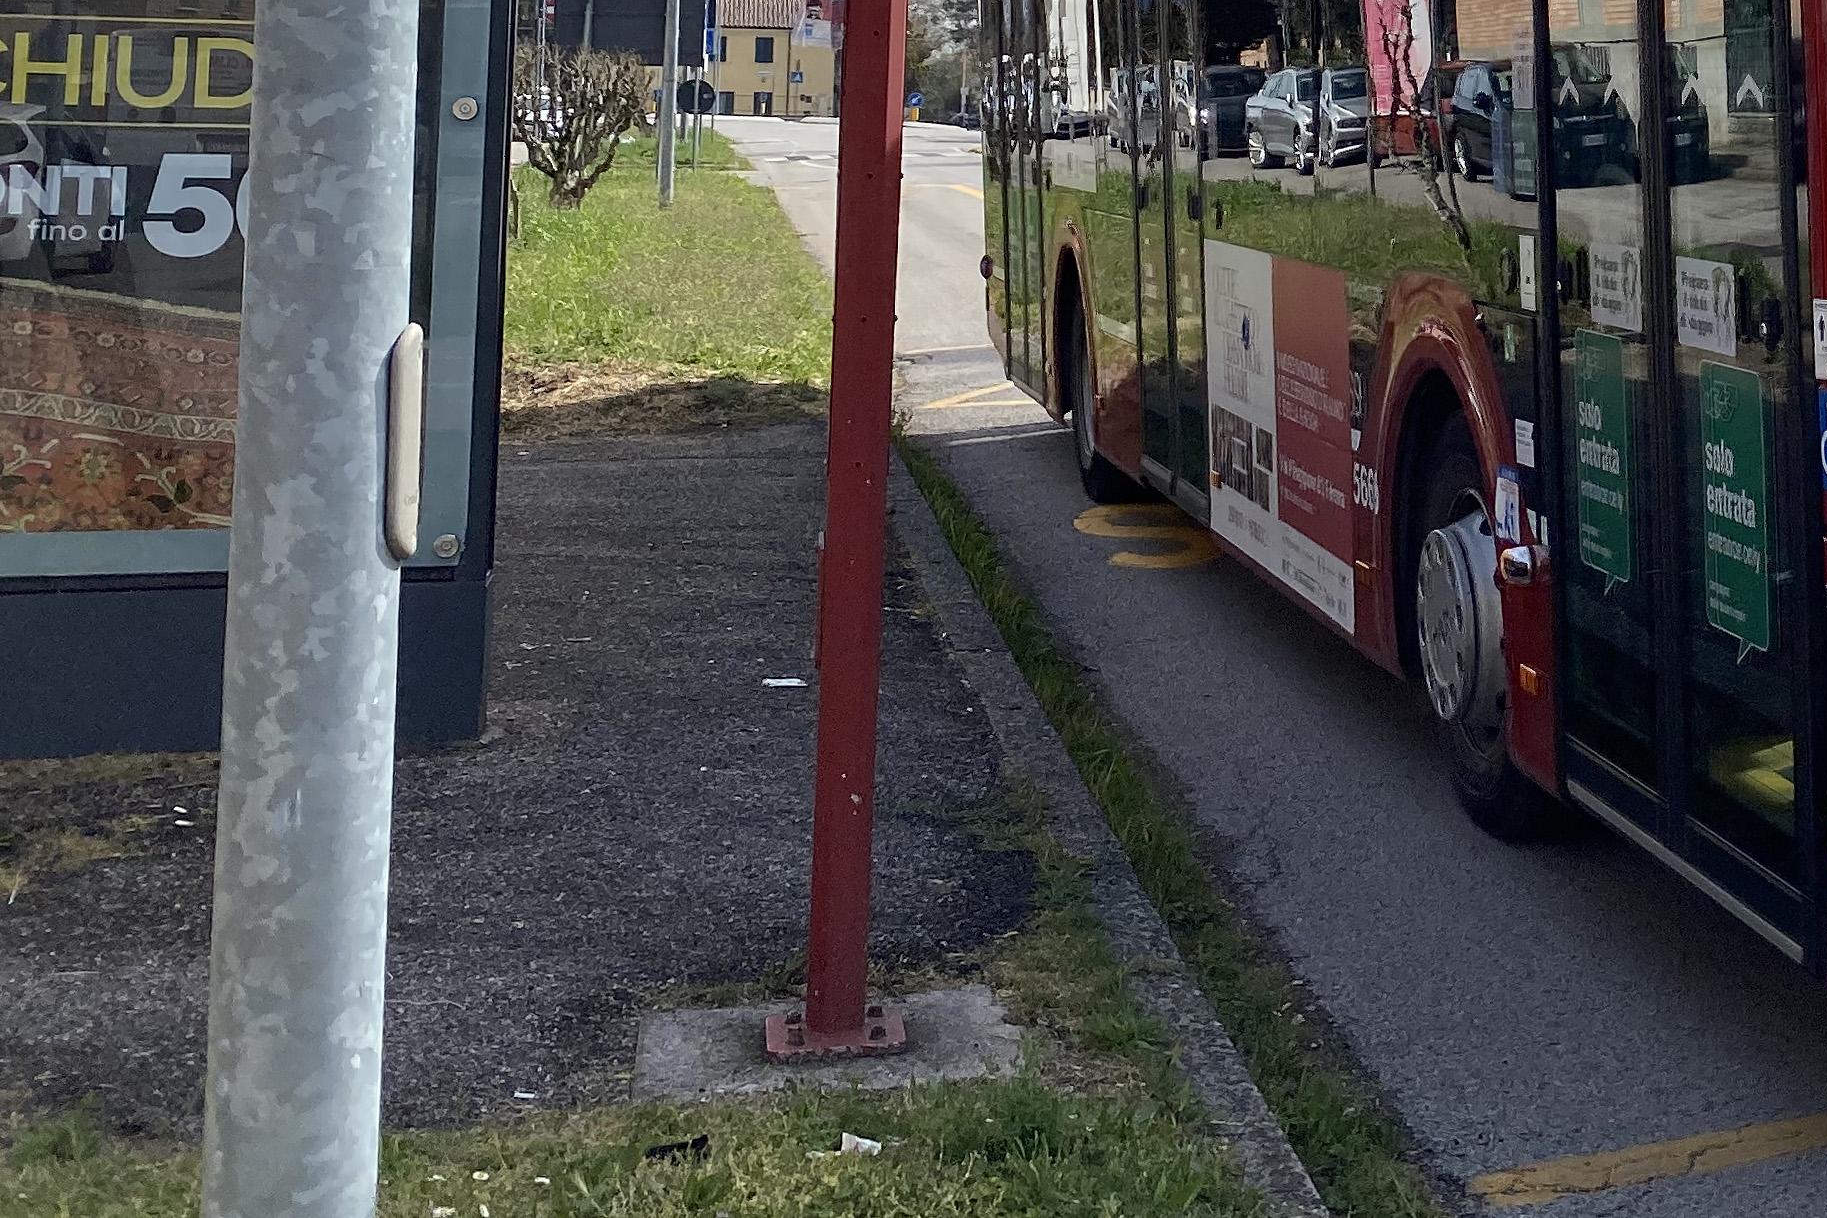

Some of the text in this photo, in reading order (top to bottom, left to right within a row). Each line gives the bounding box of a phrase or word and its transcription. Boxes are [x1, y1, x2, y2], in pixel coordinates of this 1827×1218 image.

[0, 32, 256, 109] HIUD
[0, 153, 251, 258] NTI 5
[27, 219, 125, 241] fino al
[1705, 439, 1734, 478] solo
[1706, 482, 1757, 529] entrata
